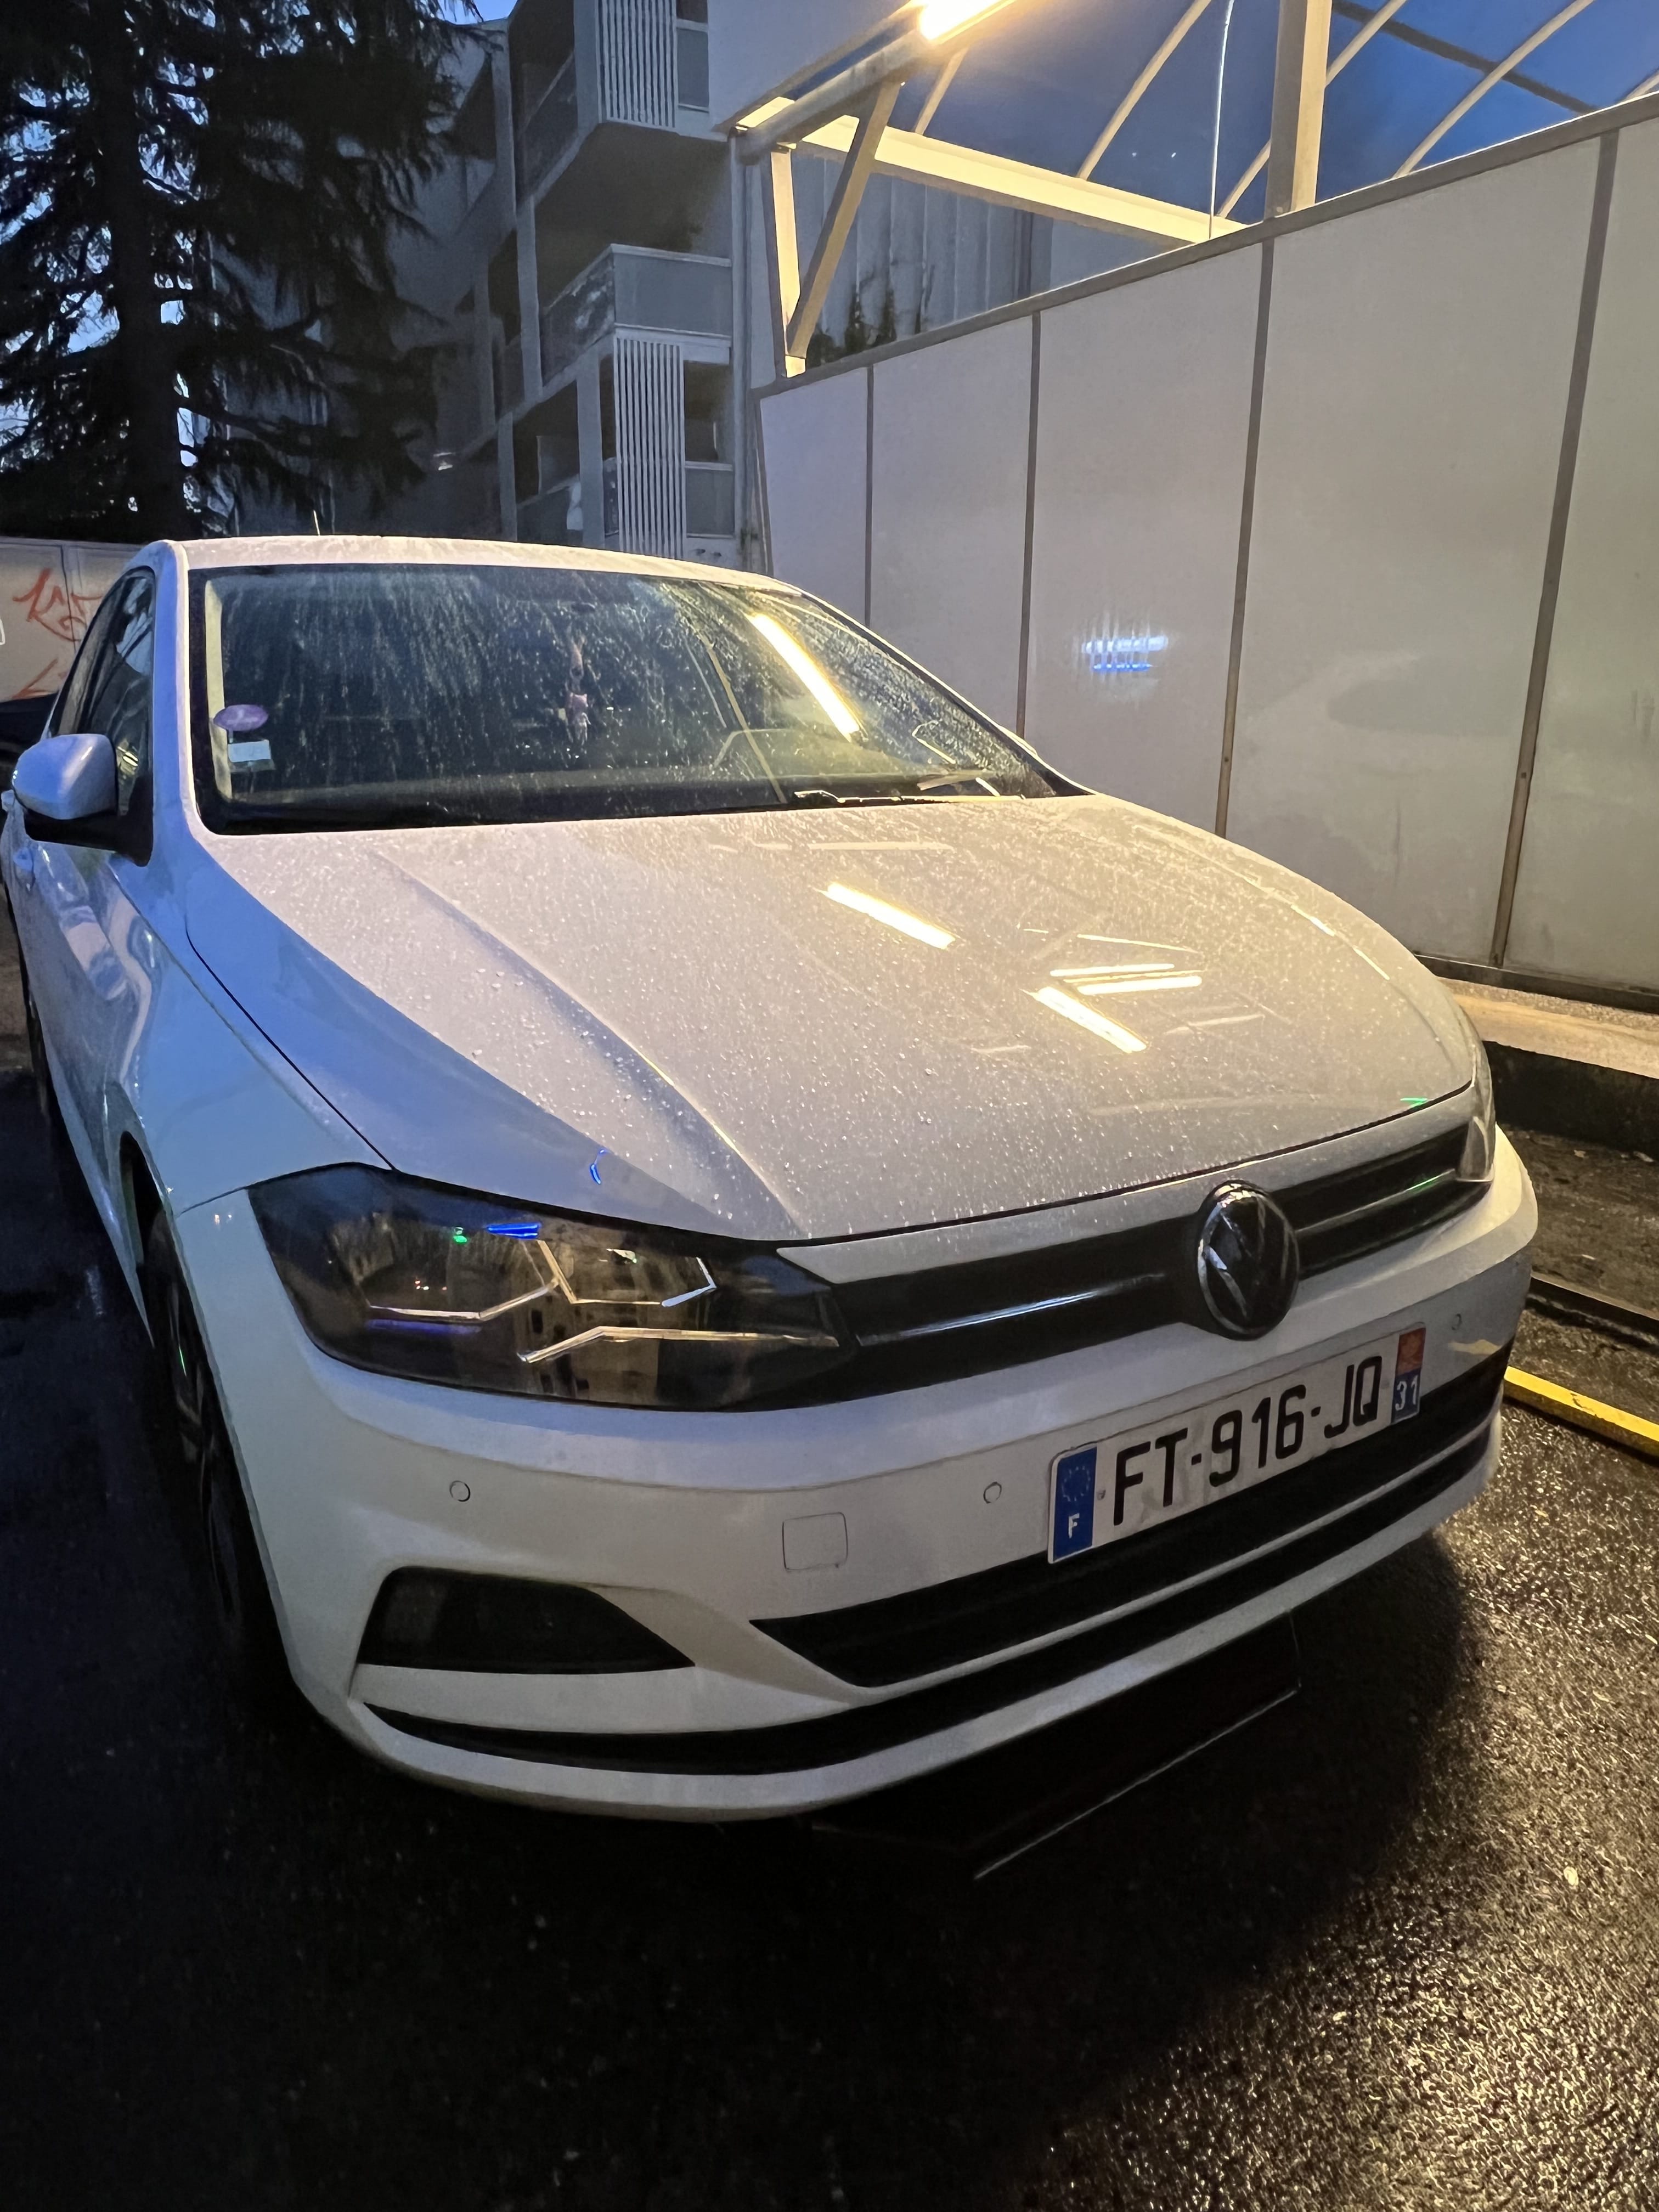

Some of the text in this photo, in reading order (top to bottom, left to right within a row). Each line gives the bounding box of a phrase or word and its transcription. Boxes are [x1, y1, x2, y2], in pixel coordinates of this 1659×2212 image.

[1395, 1375, 1418, 1411] 31
[1114, 1356, 1383, 1526] FT-916-JQ
[1068, 1513, 1080, 1538] F
